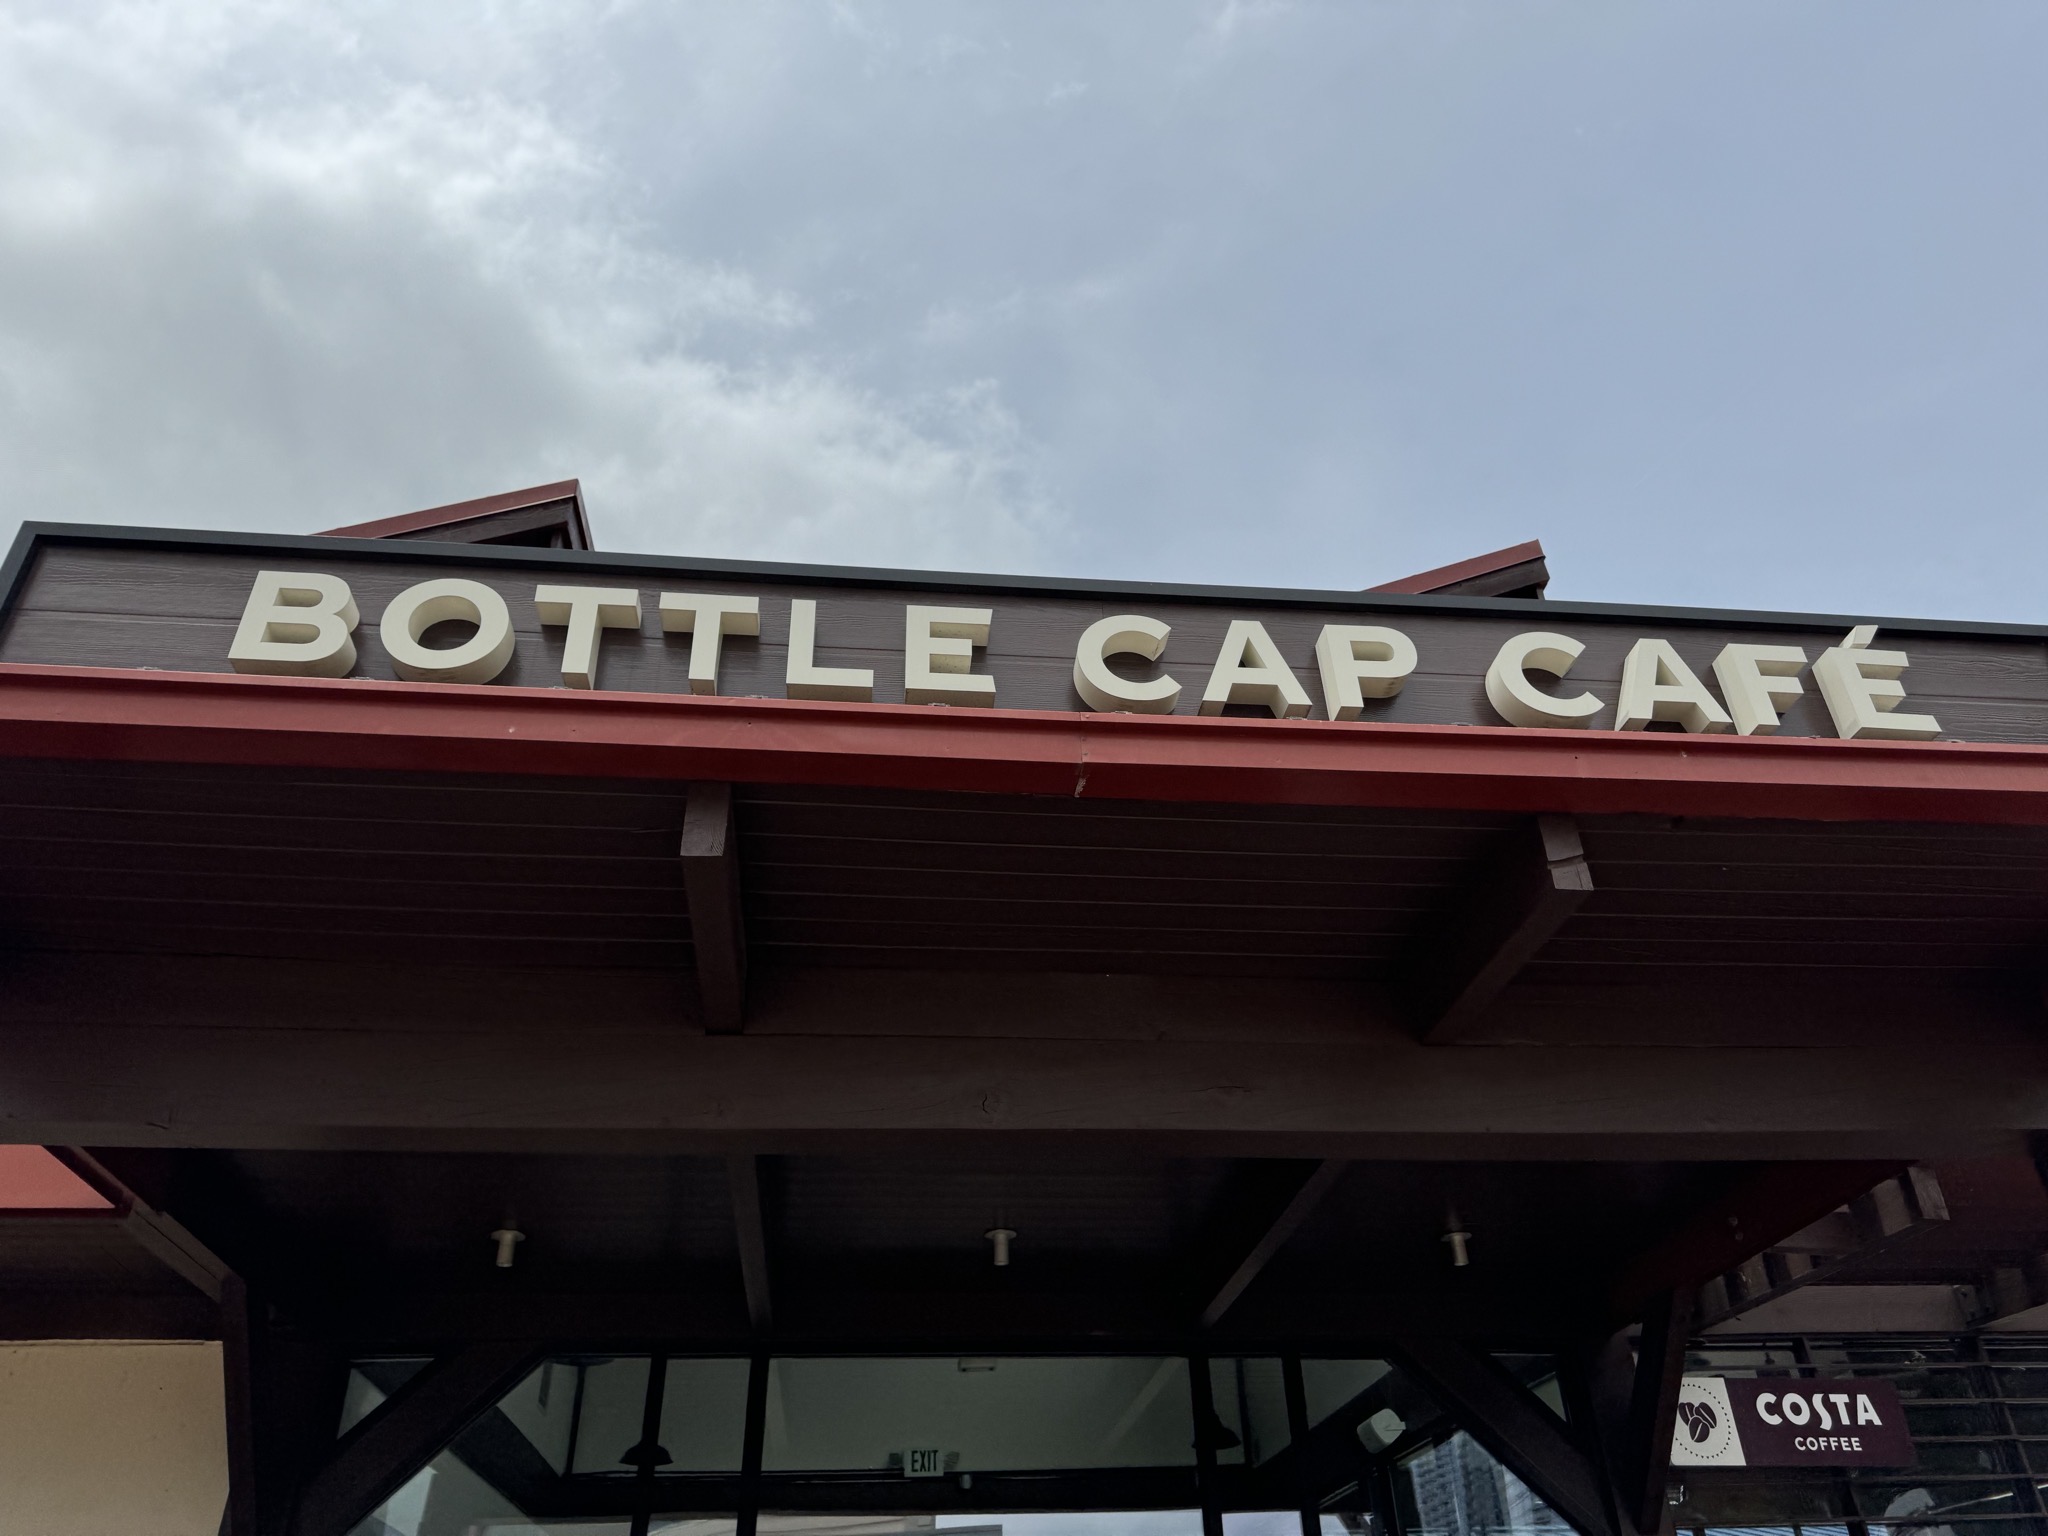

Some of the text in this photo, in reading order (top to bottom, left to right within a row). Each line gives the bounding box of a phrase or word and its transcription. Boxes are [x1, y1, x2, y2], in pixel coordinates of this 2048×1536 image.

[228, 569, 1942, 740] BOTTLE CAP CAFÉ
[1755, 1392, 1883, 1431] COSTA
[1794, 1436, 1863, 1452] COFFEE
[910, 1449, 939, 1473] EXIT
